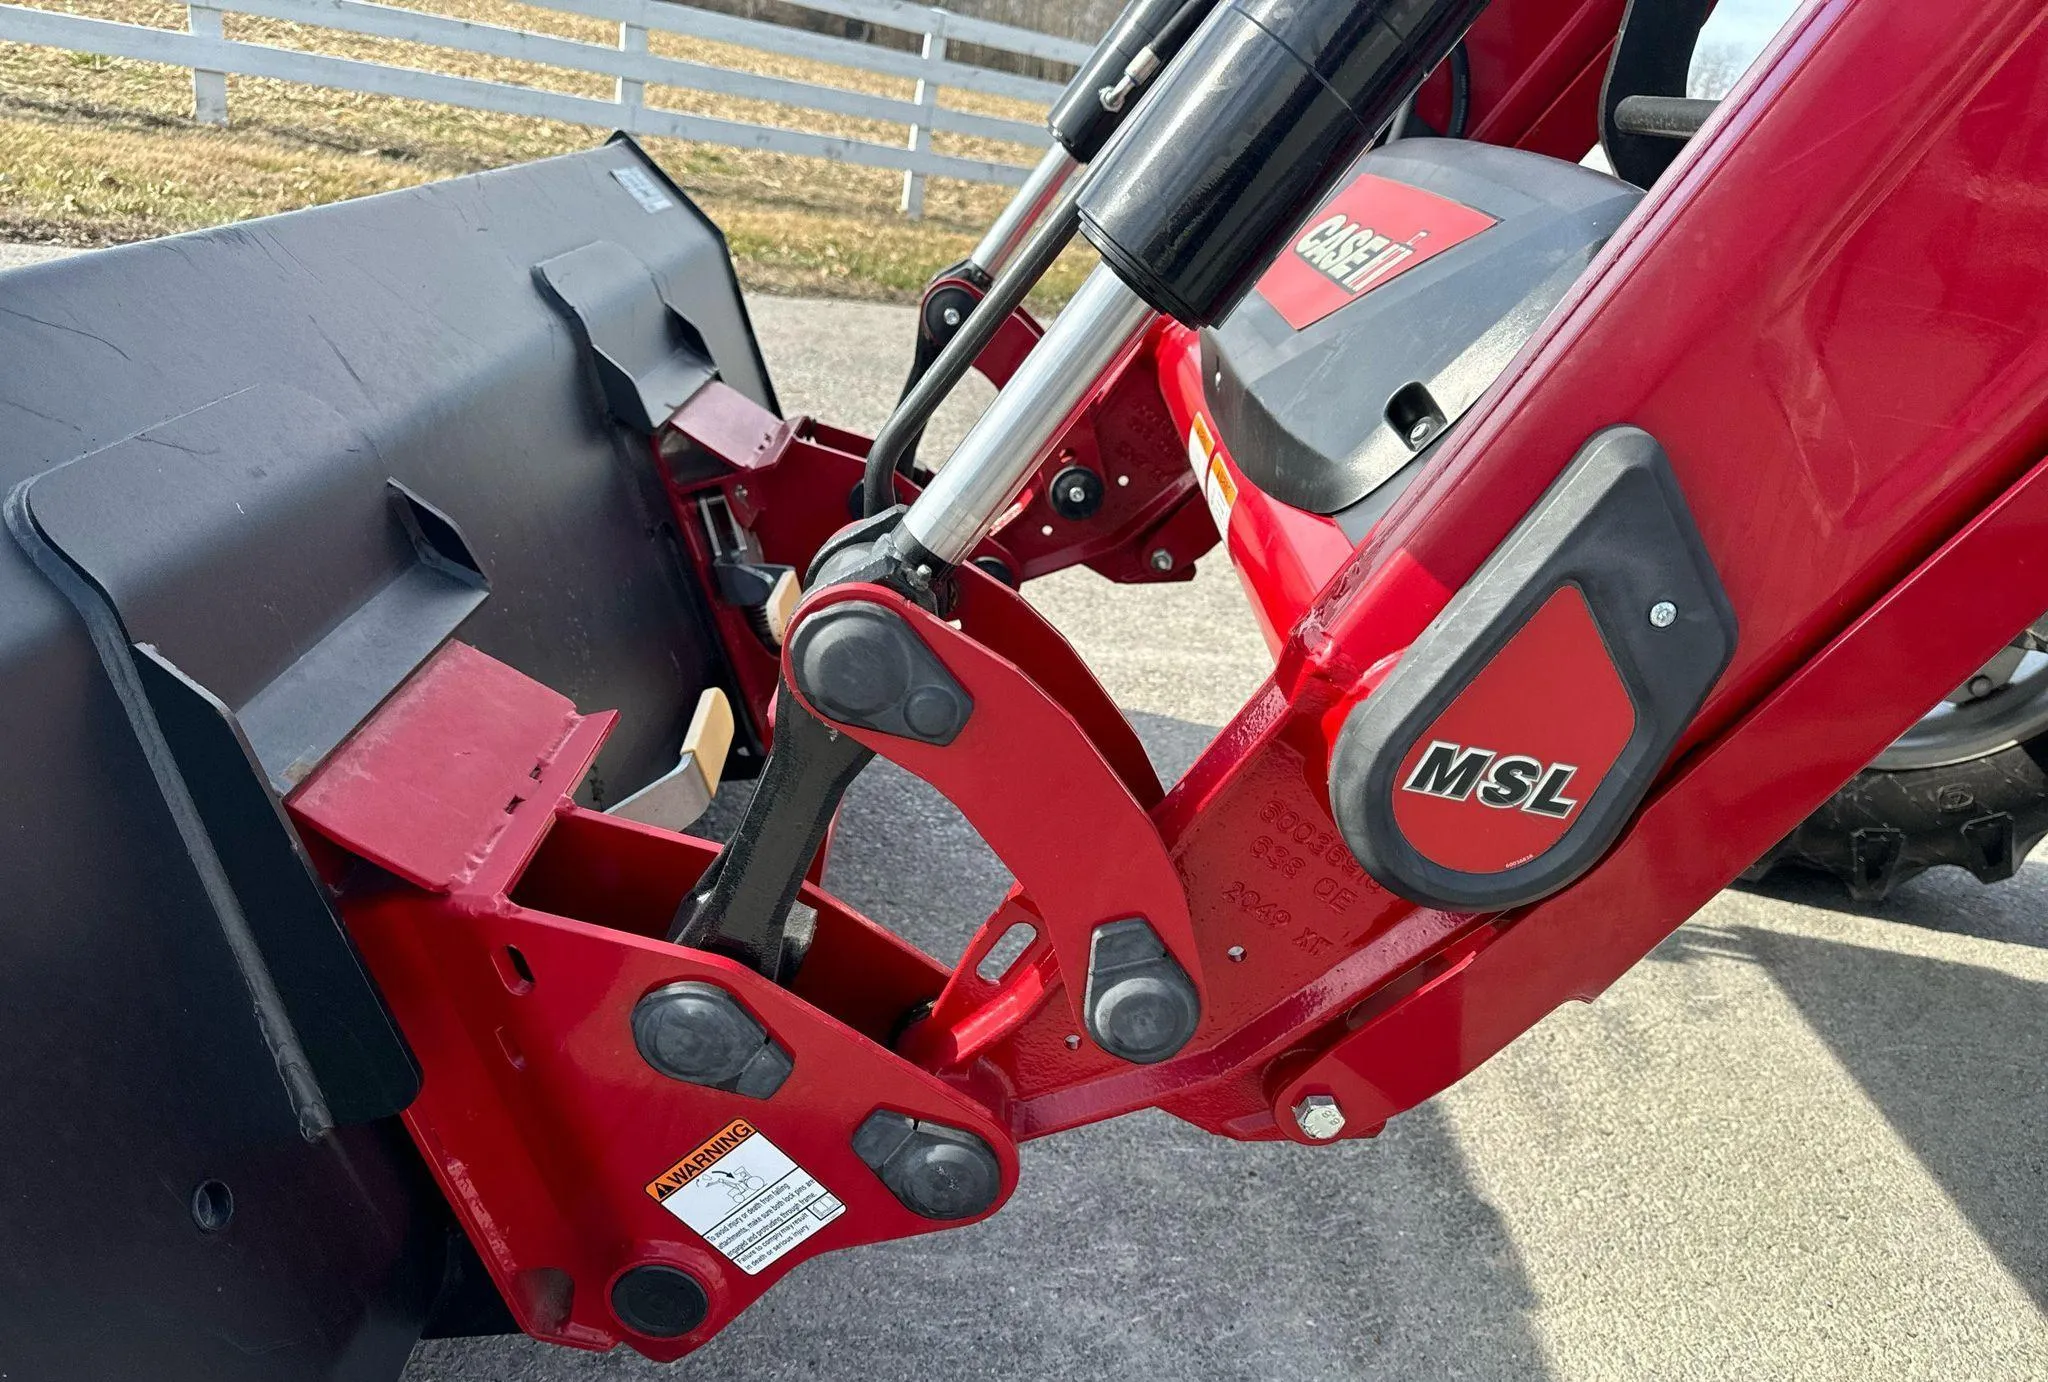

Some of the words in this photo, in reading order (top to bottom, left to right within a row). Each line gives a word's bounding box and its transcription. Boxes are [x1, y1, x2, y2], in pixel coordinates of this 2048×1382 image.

[1295, 213, 1392, 279] CASE
[1402, 740, 1578, 819] MSL
[667, 1123, 752, 1185] WARNING
[715, 1225, 730, 1239] avoid
[728, 1216, 744, 1230] injury
[747, 1202, 762, 1215] death
[760, 1193, 775, 1205] from
[771, 1182, 791, 1196] falling
[726, 1239, 749, 1258] engaged
[746, 1232, 758, 1243] and
[756, 1216, 784, 1235] protruding
[780, 1202, 800, 1218] through
[798, 1192, 817, 1204] frame.
[747, 1216, 763, 1229] make
[761, 1207, 774, 1219] sure
[771, 1199, 785, 1212] both
[782, 1191, 796, 1202] lock
[794, 1184, 807, 1197] pins
[805, 1178, 816, 1188] are
[736, 1248, 757, 1264] Failure
[755, 1244, 763, 1252] to
[762, 1232, 782, 1247] comply
[780, 1223, 795, 1236] may
[792, 1212, 809, 1226] result
[751, 1253, 768, 1267] death
[773, 1236, 793, 1251] serious
